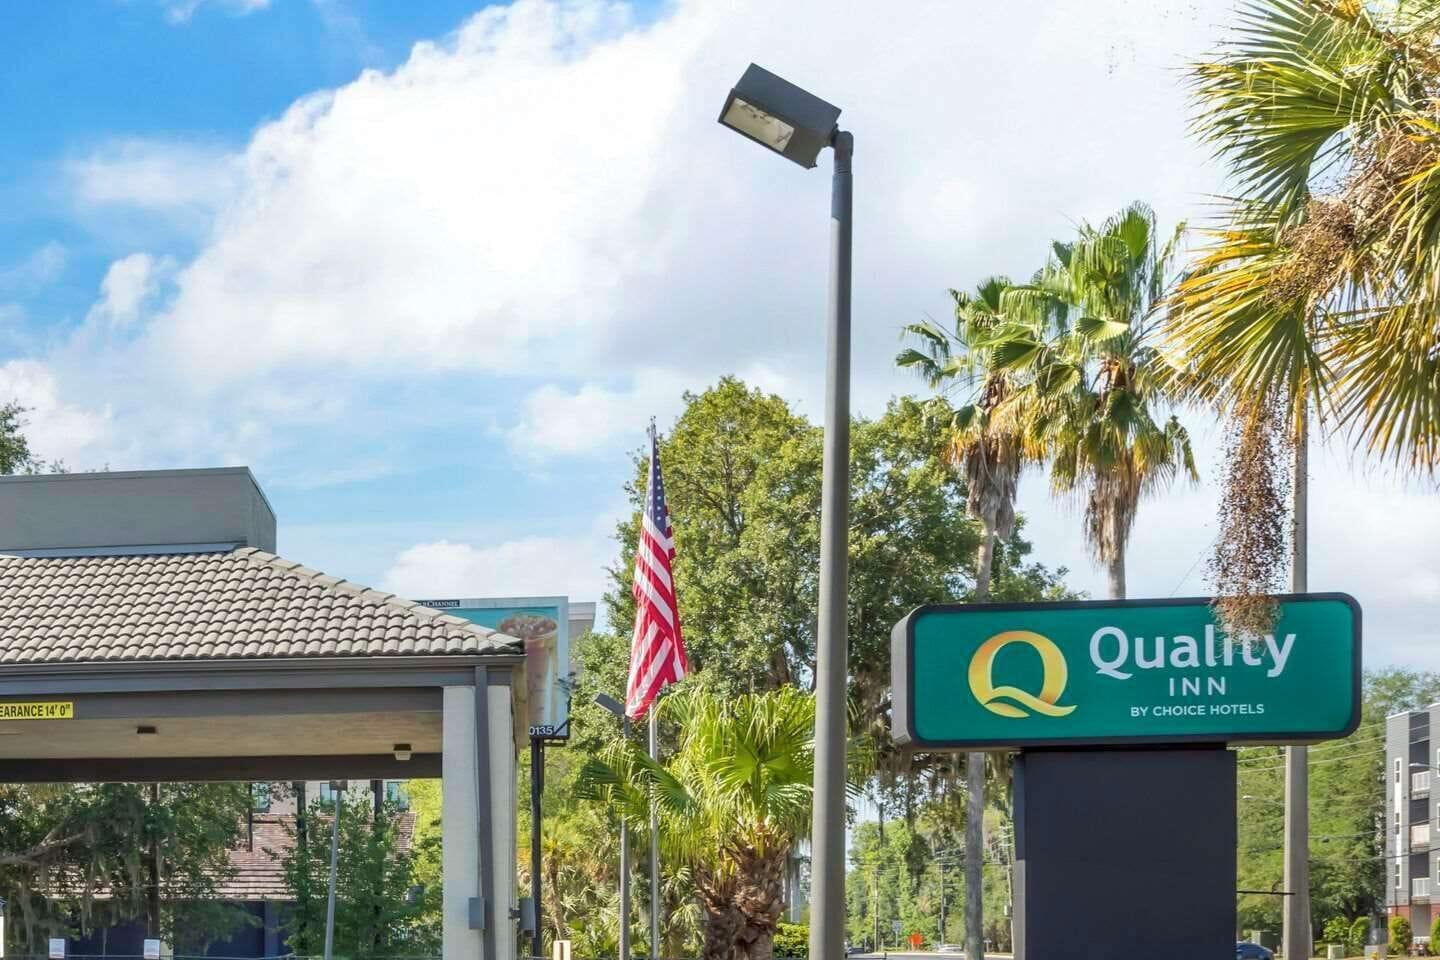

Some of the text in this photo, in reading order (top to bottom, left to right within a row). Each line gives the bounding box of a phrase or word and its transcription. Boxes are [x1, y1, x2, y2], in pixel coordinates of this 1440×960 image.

[1089, 624, 1297, 680] Quality
[967, 630, 1078, 718] Q
[1168, 676, 1226, 697] INN
[1130, 703, 1265, 717] BY CHOICE HOTELS
[528, 726, 553, 736] 0135
